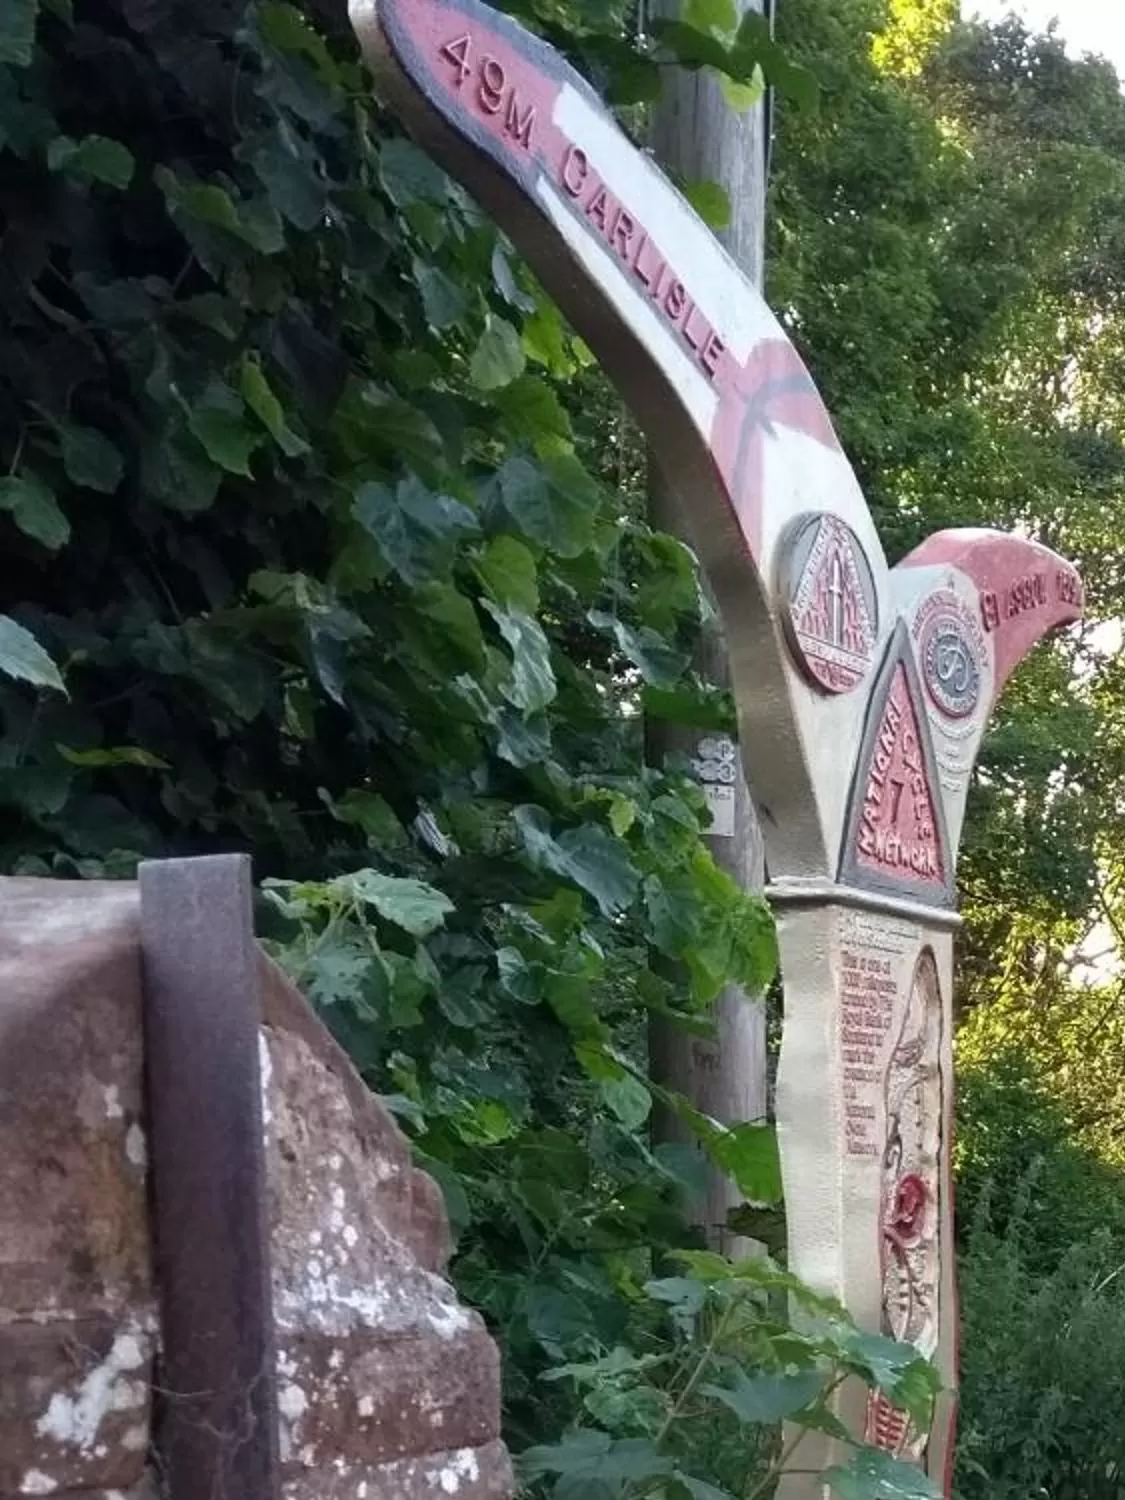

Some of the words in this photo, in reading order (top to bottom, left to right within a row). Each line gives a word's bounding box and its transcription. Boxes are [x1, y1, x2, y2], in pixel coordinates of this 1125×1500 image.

[438, 33, 536, 149] 49M
[562, 143, 725, 379] CARLISLE
[857, 694, 901, 858] NATIONAL
